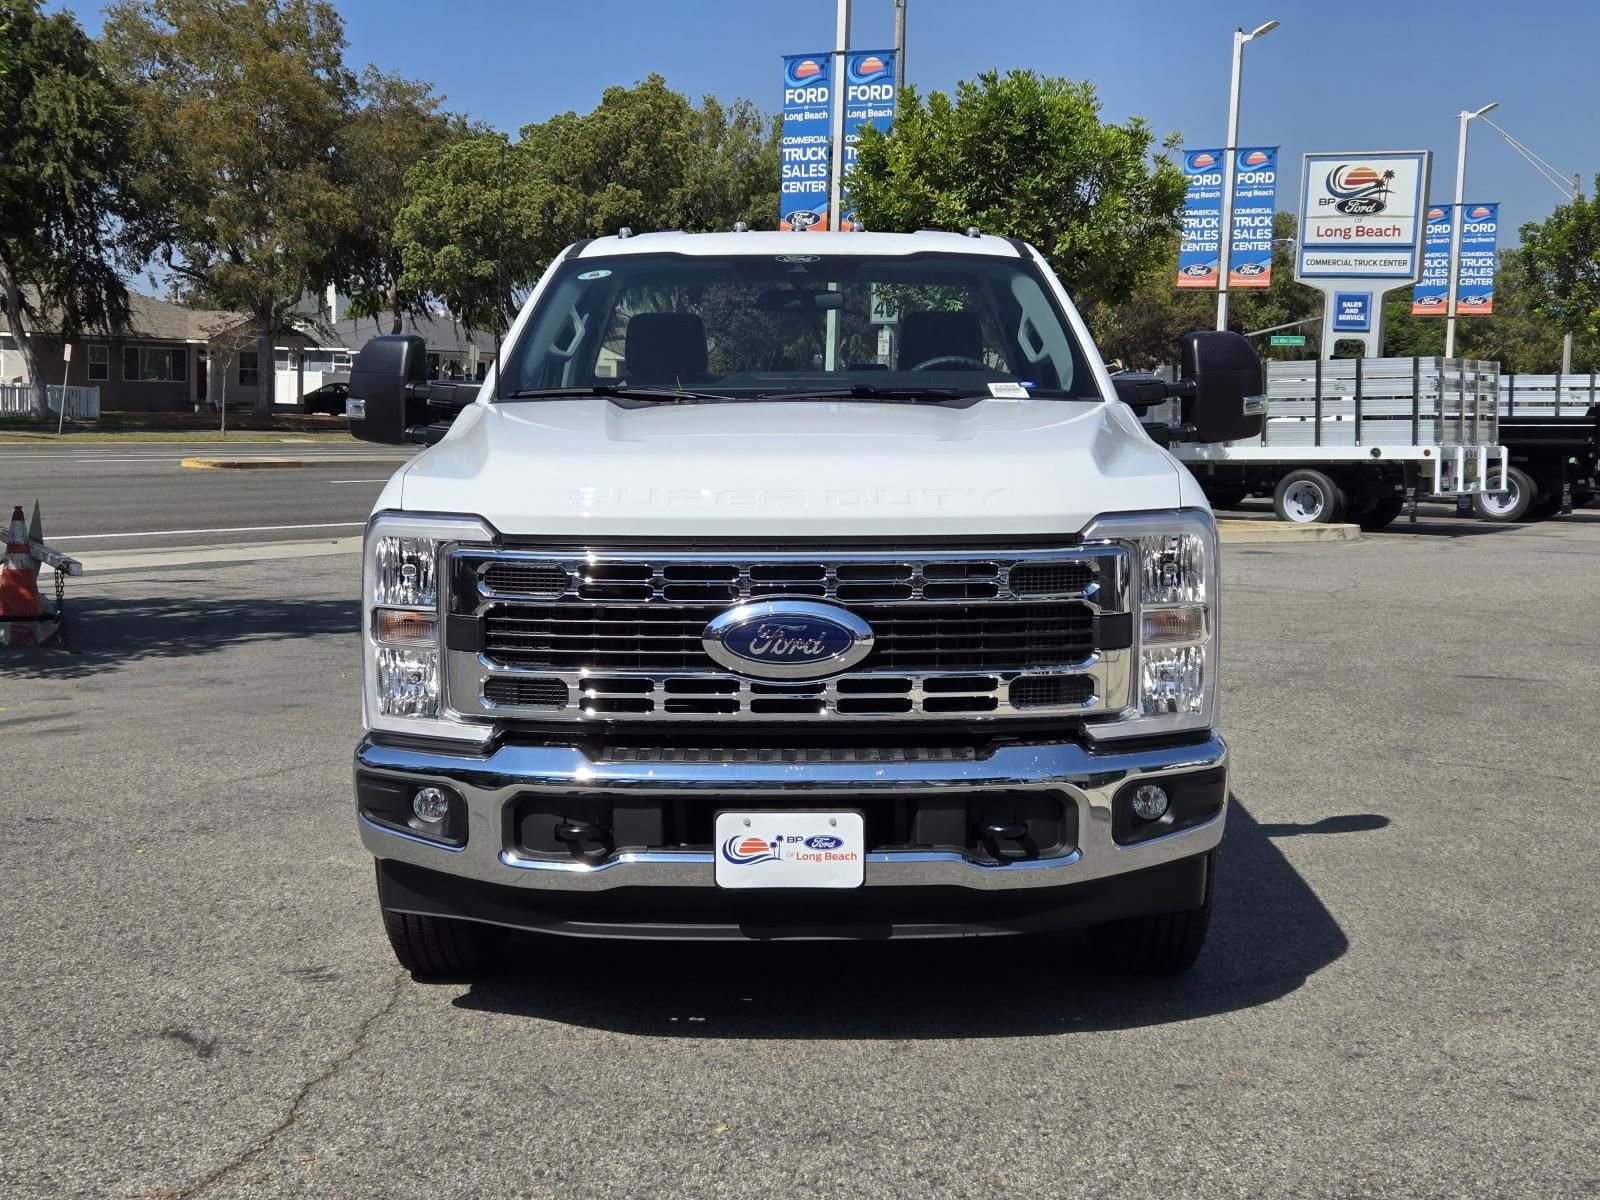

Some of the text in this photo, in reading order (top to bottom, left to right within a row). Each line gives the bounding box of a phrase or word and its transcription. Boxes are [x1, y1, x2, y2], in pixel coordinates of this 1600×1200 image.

[785, 88, 828, 104] FORD
[848, 85, 893, 100] FORD
[784, 111, 828, 122] Long Beach
[848, 109, 892, 118] Long Beach
[783, 135, 828, 145] COMMERCIAL
[783, 147, 827, 162] TRUCK
[782, 164, 826, 178] SALES
[1237, 172, 1275, 184] FORD
[782, 181, 826, 193] CENTER
[1344, 200, 1376, 214] Ford
[792, 212, 814, 225] Ford
[1182, 218, 1219, 228] TRUCK
[1234, 217, 1272, 227] TRUCK
[1316, 225, 1401, 240] Long Beach
[1426, 224, 1450, 234] ORD
[1464, 224, 1496, 233] FORD
[1182, 230, 1218, 241] SALES
[1233, 229, 1272, 239] SALES
[1181, 242, 1218, 252] CENTER
[1233, 241, 1271, 251] CENTER
[1306, 259, 1352, 267] COMMERCIAL
[1424, 259, 1448, 267] RUCK
[1461, 258, 1494, 266] TRUCK
[1188, 266, 1208, 275] Ford
[1240, 265, 1260, 274] Ford
[1423, 269, 1448, 277] ALES
[568, 486, 1010, 505] SUPER DUTY
[748, 623, 826, 656] Ford
[812, 838, 836, 848] Ford
[796, 852, 822, 862] Long
[825, 852, 857, 861] Beach
